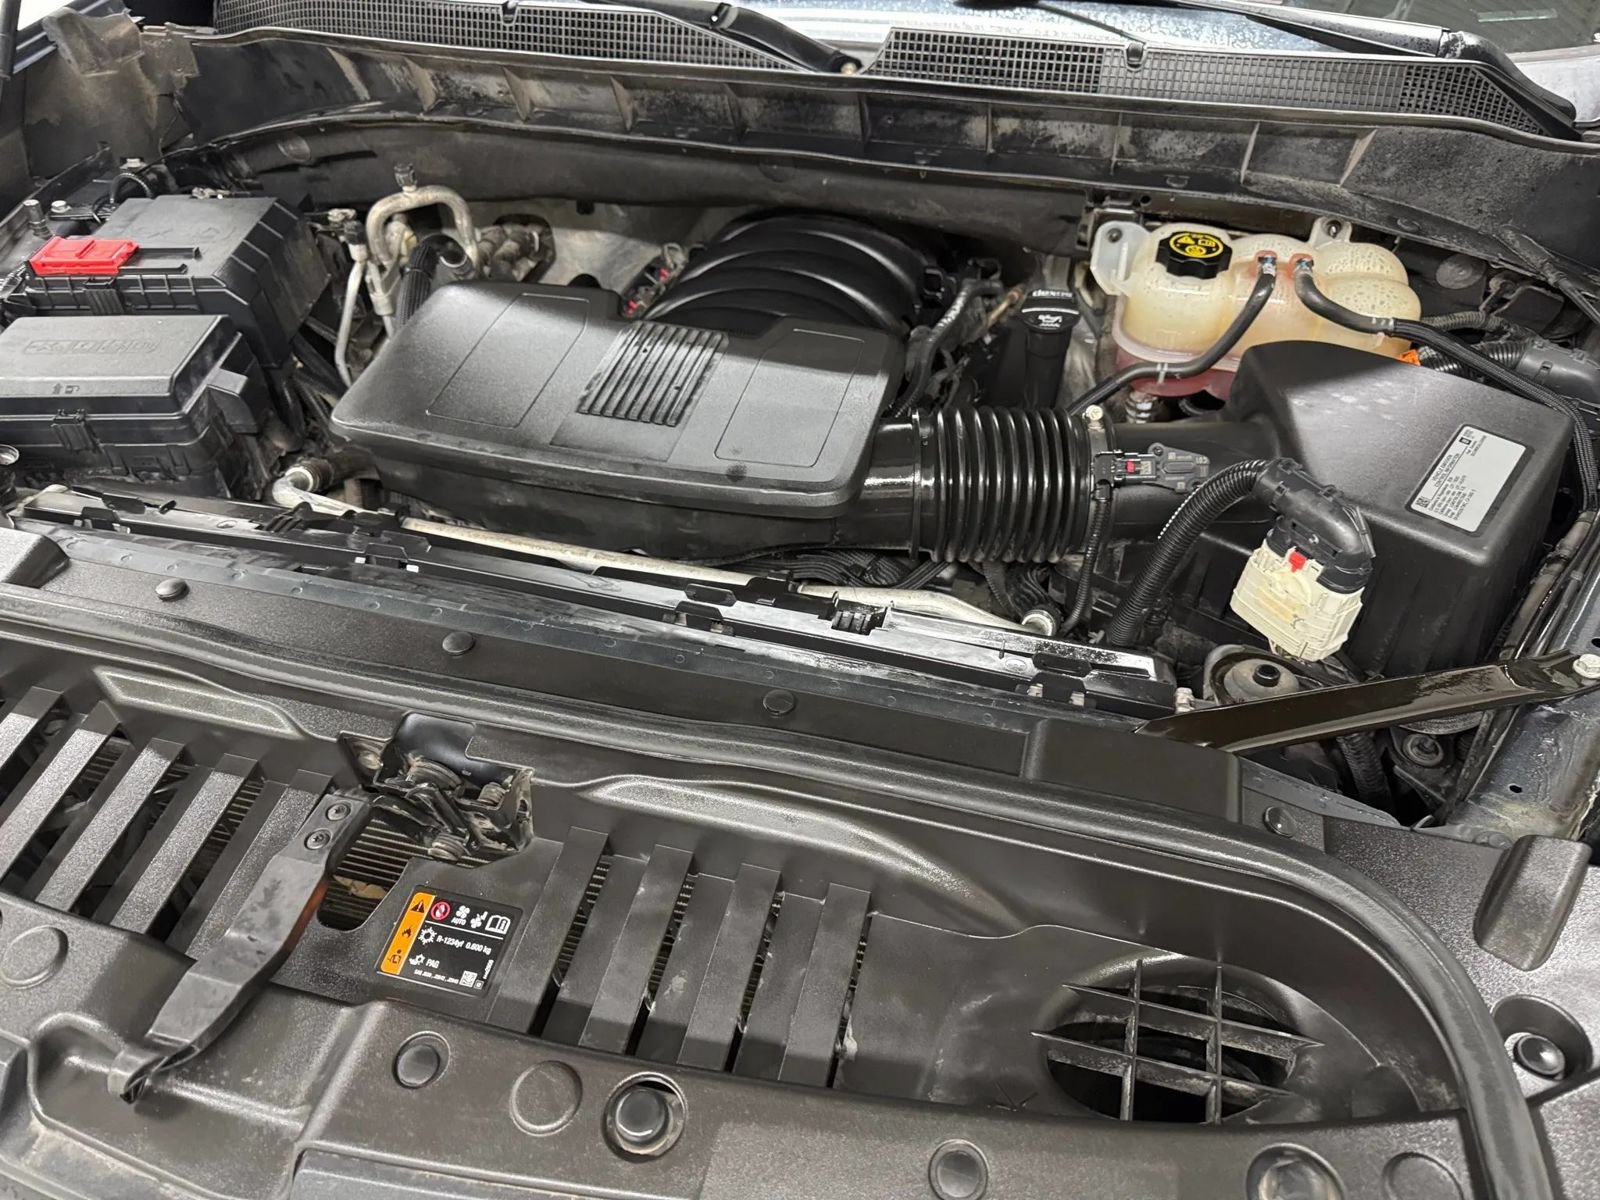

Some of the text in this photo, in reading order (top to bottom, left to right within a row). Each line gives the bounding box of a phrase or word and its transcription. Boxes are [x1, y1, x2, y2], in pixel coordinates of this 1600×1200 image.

[451, 918, 467, 926] AUTO
[436, 935, 464, 948] R-1234yf
[482, 946, 492, 956] kg
[426, 958, 440, 968] PAG
